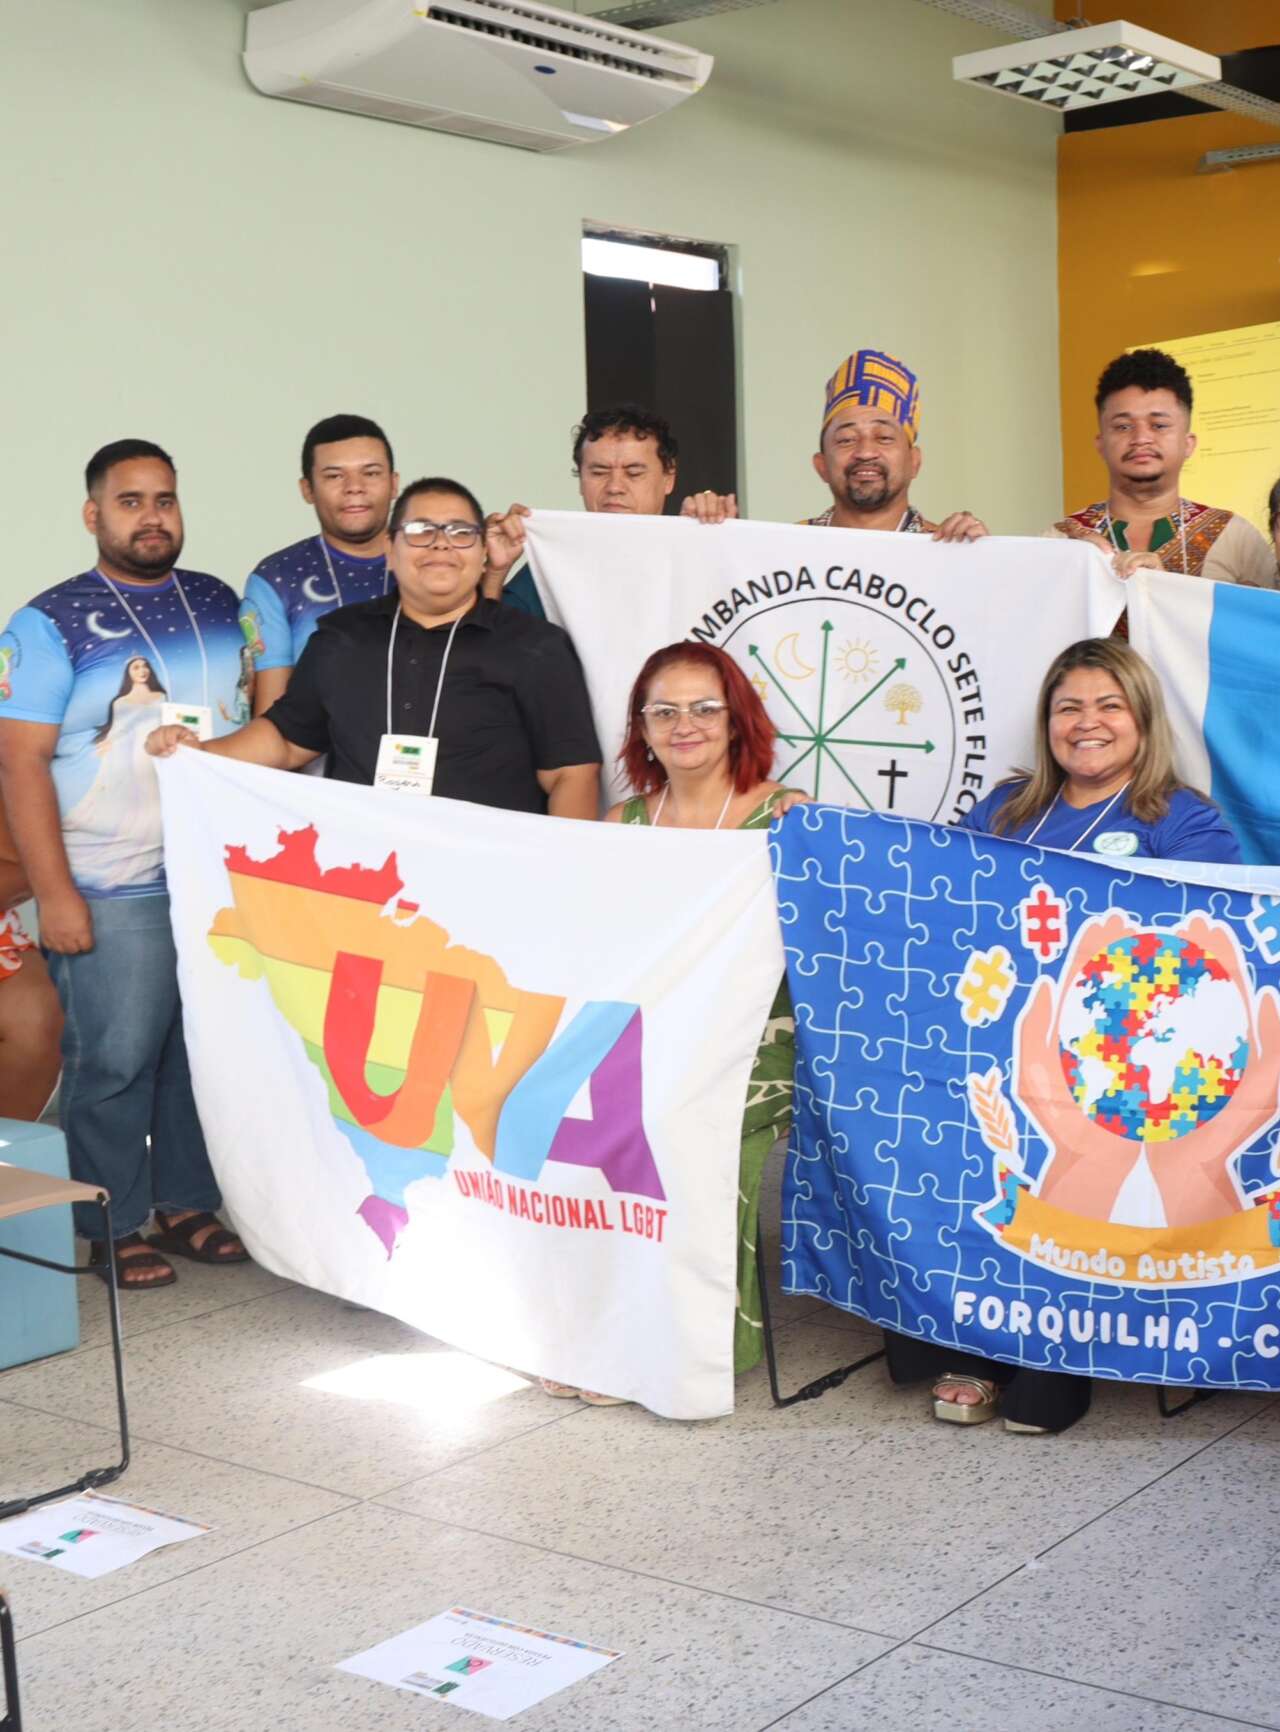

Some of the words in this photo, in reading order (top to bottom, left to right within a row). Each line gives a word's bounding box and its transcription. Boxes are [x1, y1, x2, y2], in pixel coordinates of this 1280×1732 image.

[684, 565, 816, 644] MBANDA
[825, 565, 956, 651] CABOCLO
[946, 651, 986, 726] SETE
[453, 1169, 505, 1211] UNIÃO
[508, 1184, 614, 1231] NACIONAL
[620, 1201, 668, 1243] LGBT
[1029, 1233, 1126, 1278] Mundo
[1137, 1250, 1255, 1281] Autista
[953, 1291, 1199, 1353] FORQUILHA
